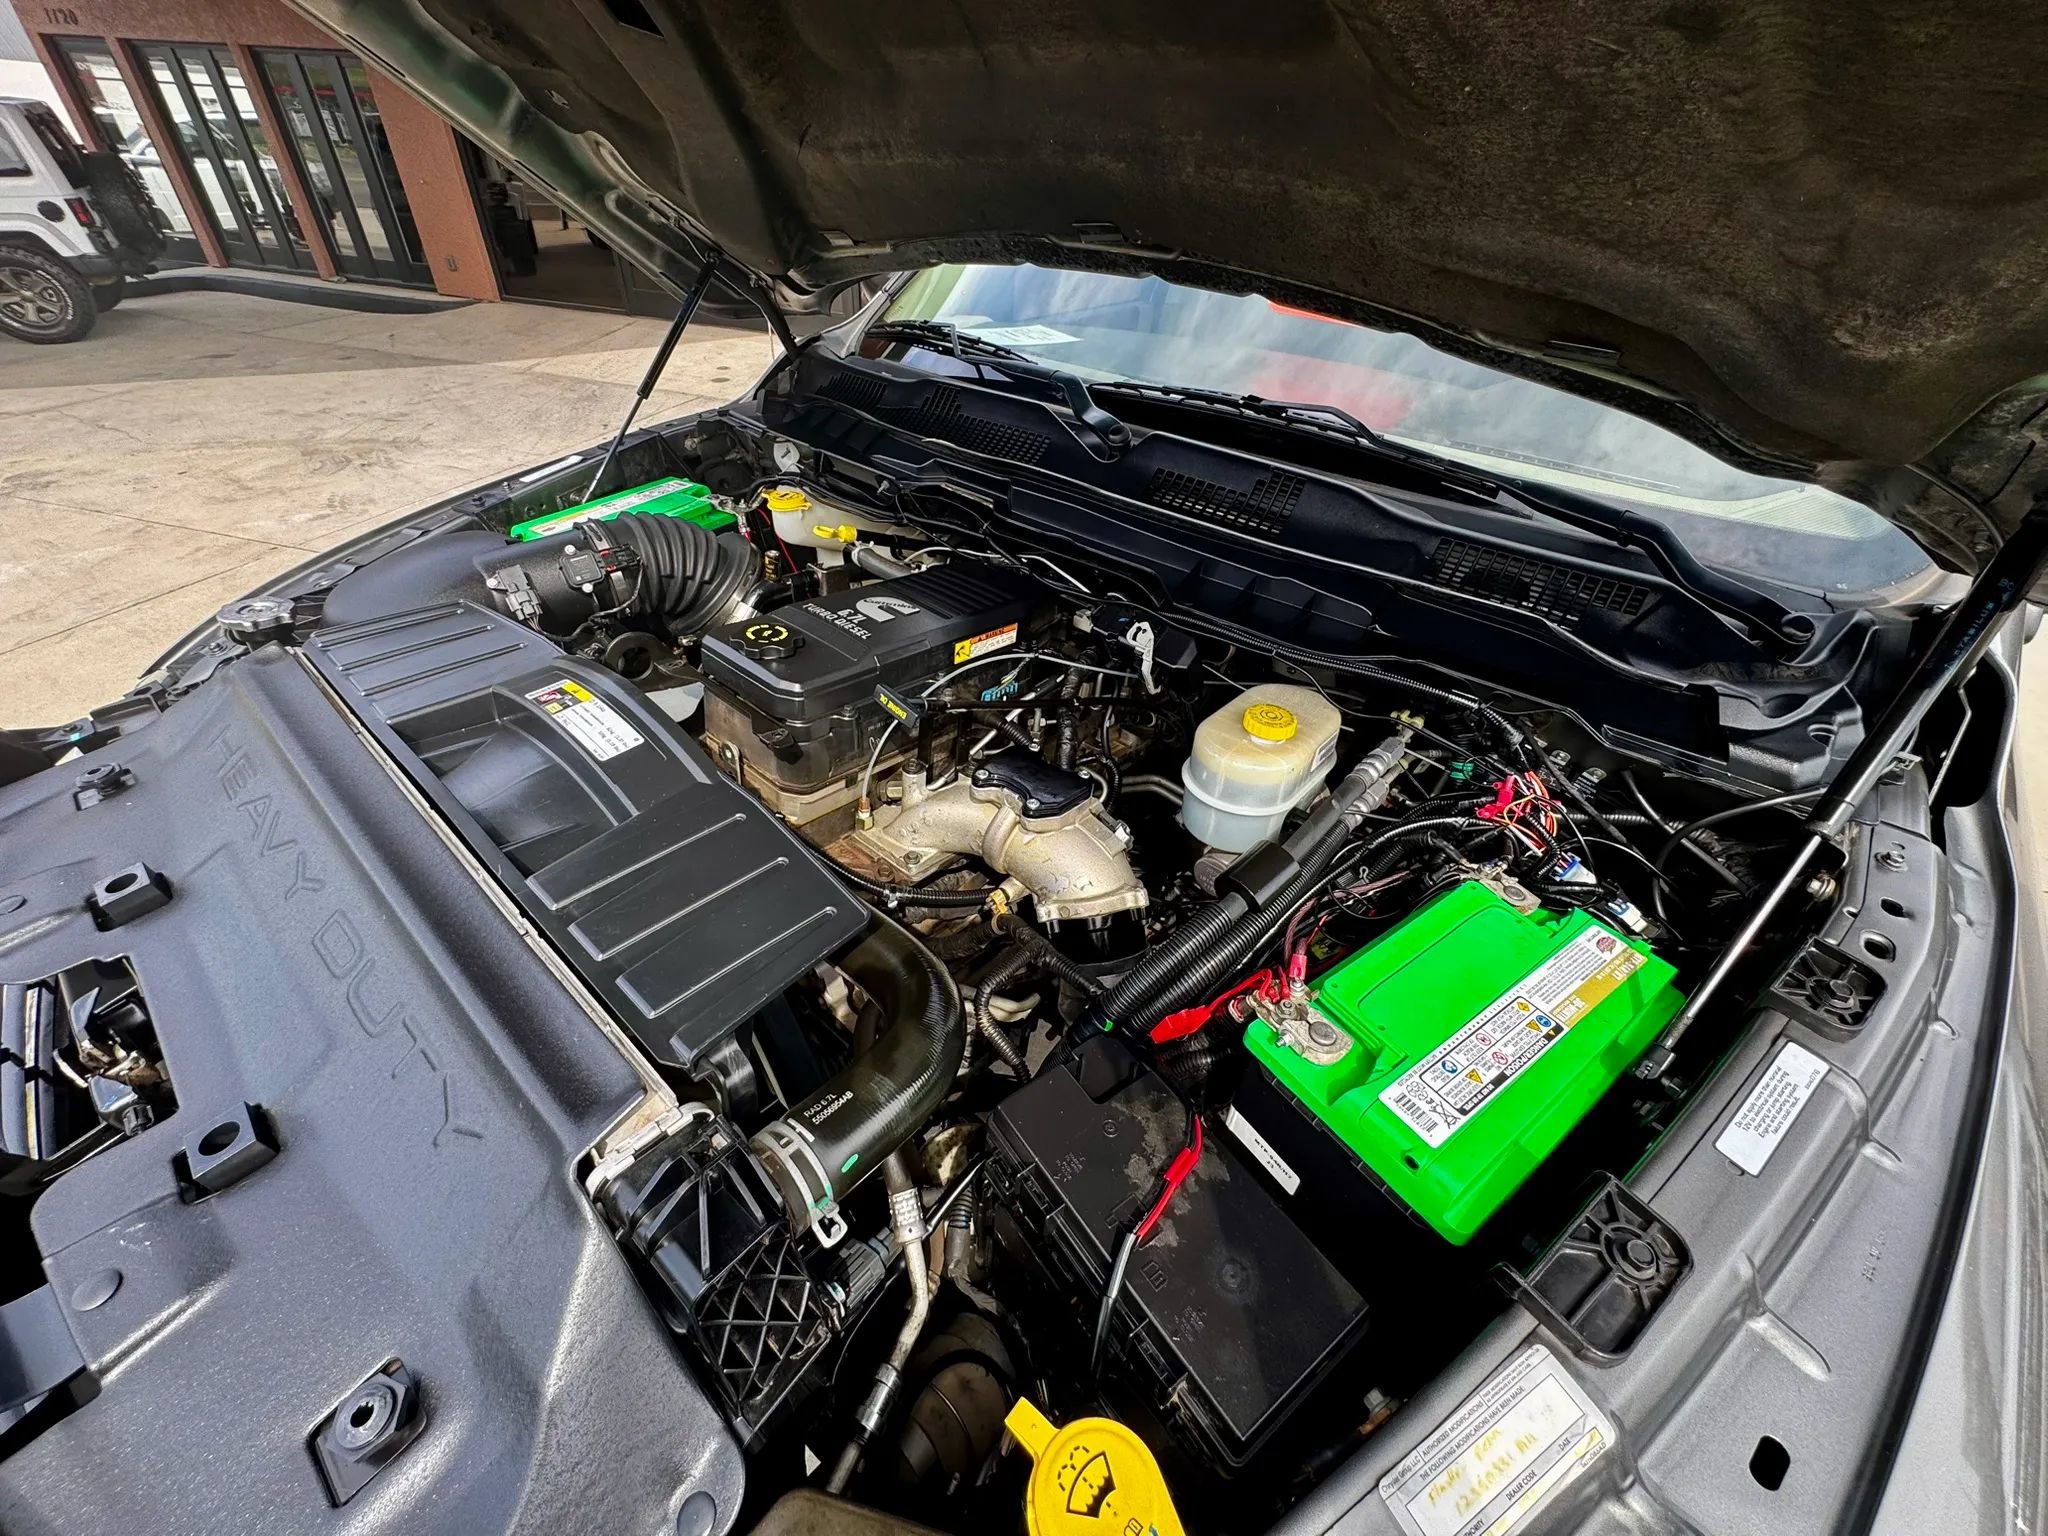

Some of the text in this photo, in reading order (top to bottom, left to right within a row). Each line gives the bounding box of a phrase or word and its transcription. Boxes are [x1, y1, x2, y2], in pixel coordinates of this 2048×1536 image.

[801, 602, 872, 640] TURBO DIESEL
[206, 725, 485, 1148] HEAVY DUTY
[1502, 1036, 1548, 1076] DANGER/POISON
[803, 1101, 822, 1119] RAD
[1734, 1119, 1743, 1128] Do
[1739, 1112, 1748, 1121] not
[1744, 1101, 1757, 1114] apply
[1753, 1090, 1764, 1102] more
[1760, 1080, 1771, 1091] than
[1741, 1121, 1752, 1132] 12V
[1752, 1098, 1769, 1117] electrical
[1757, 1122, 1772, 1138] Engine
[1768, 1114, 1778, 1123] and
[1418, 1469, 1431, 1481] THE
[1426, 1446, 1456, 1474] FOLLOWING
[1453, 1415, 1490, 1450] MODIFICATIONS
[1486, 1405, 1502, 1420] HAVE
[1497, 1395, 1512, 1410] BEEN
[1421, 1430, 1450, 1457] AUTHORIZED
[1447, 1399, 1484, 1434] MODIFICATIONS
[1380, 1455, 1421, 1494] Chrysler Group LLC
[1504, 1481, 1525, 1500] DEALER
[1520, 1469, 1537, 1485] CODE
[1557, 1437, 1572, 1451] DATE
